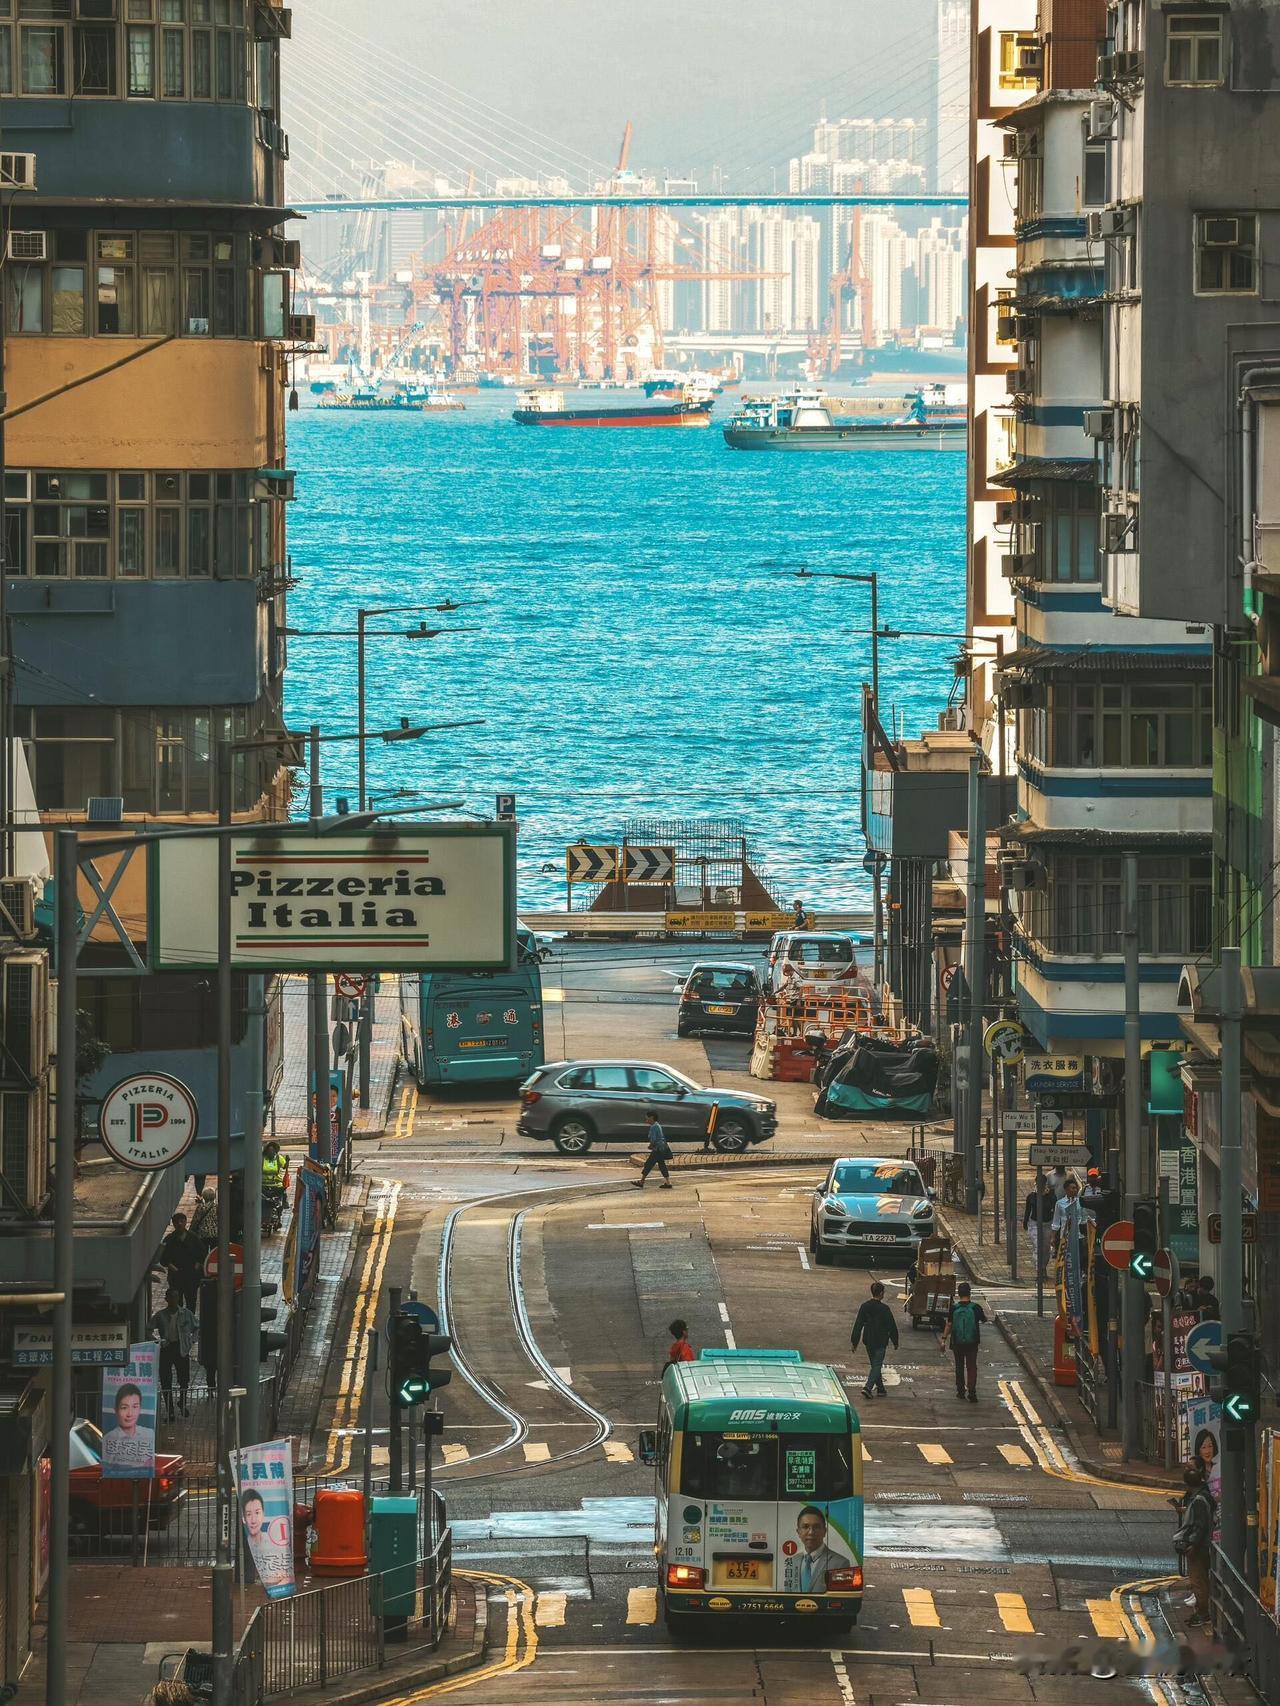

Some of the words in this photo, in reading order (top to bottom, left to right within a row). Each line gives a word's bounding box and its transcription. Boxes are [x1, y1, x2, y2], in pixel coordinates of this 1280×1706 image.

[500, 796, 512, 812] P
[230, 869, 446, 897] Pizzeria
[248, 901, 417, 928] Italia
[1031, 1060, 1078, 1070] 洗衣服務
[1056, 1079, 1080, 1088] SERVICE
[121, 1085, 175, 1101] PIZZERIA
[128, 1147, 169, 1159] ITALIA
[1180, 1145, 1197, 1228] 香港置業
[730, 1409, 767, 1420] AMS
[675, 1547, 693, 1556] 12.10
[737, 1561, 749, 1570] YE
[729, 1569, 757, 1578] 6374
[743, 1602, 761, 1610] 2751
[764, 1602, 784, 1610] 6666
